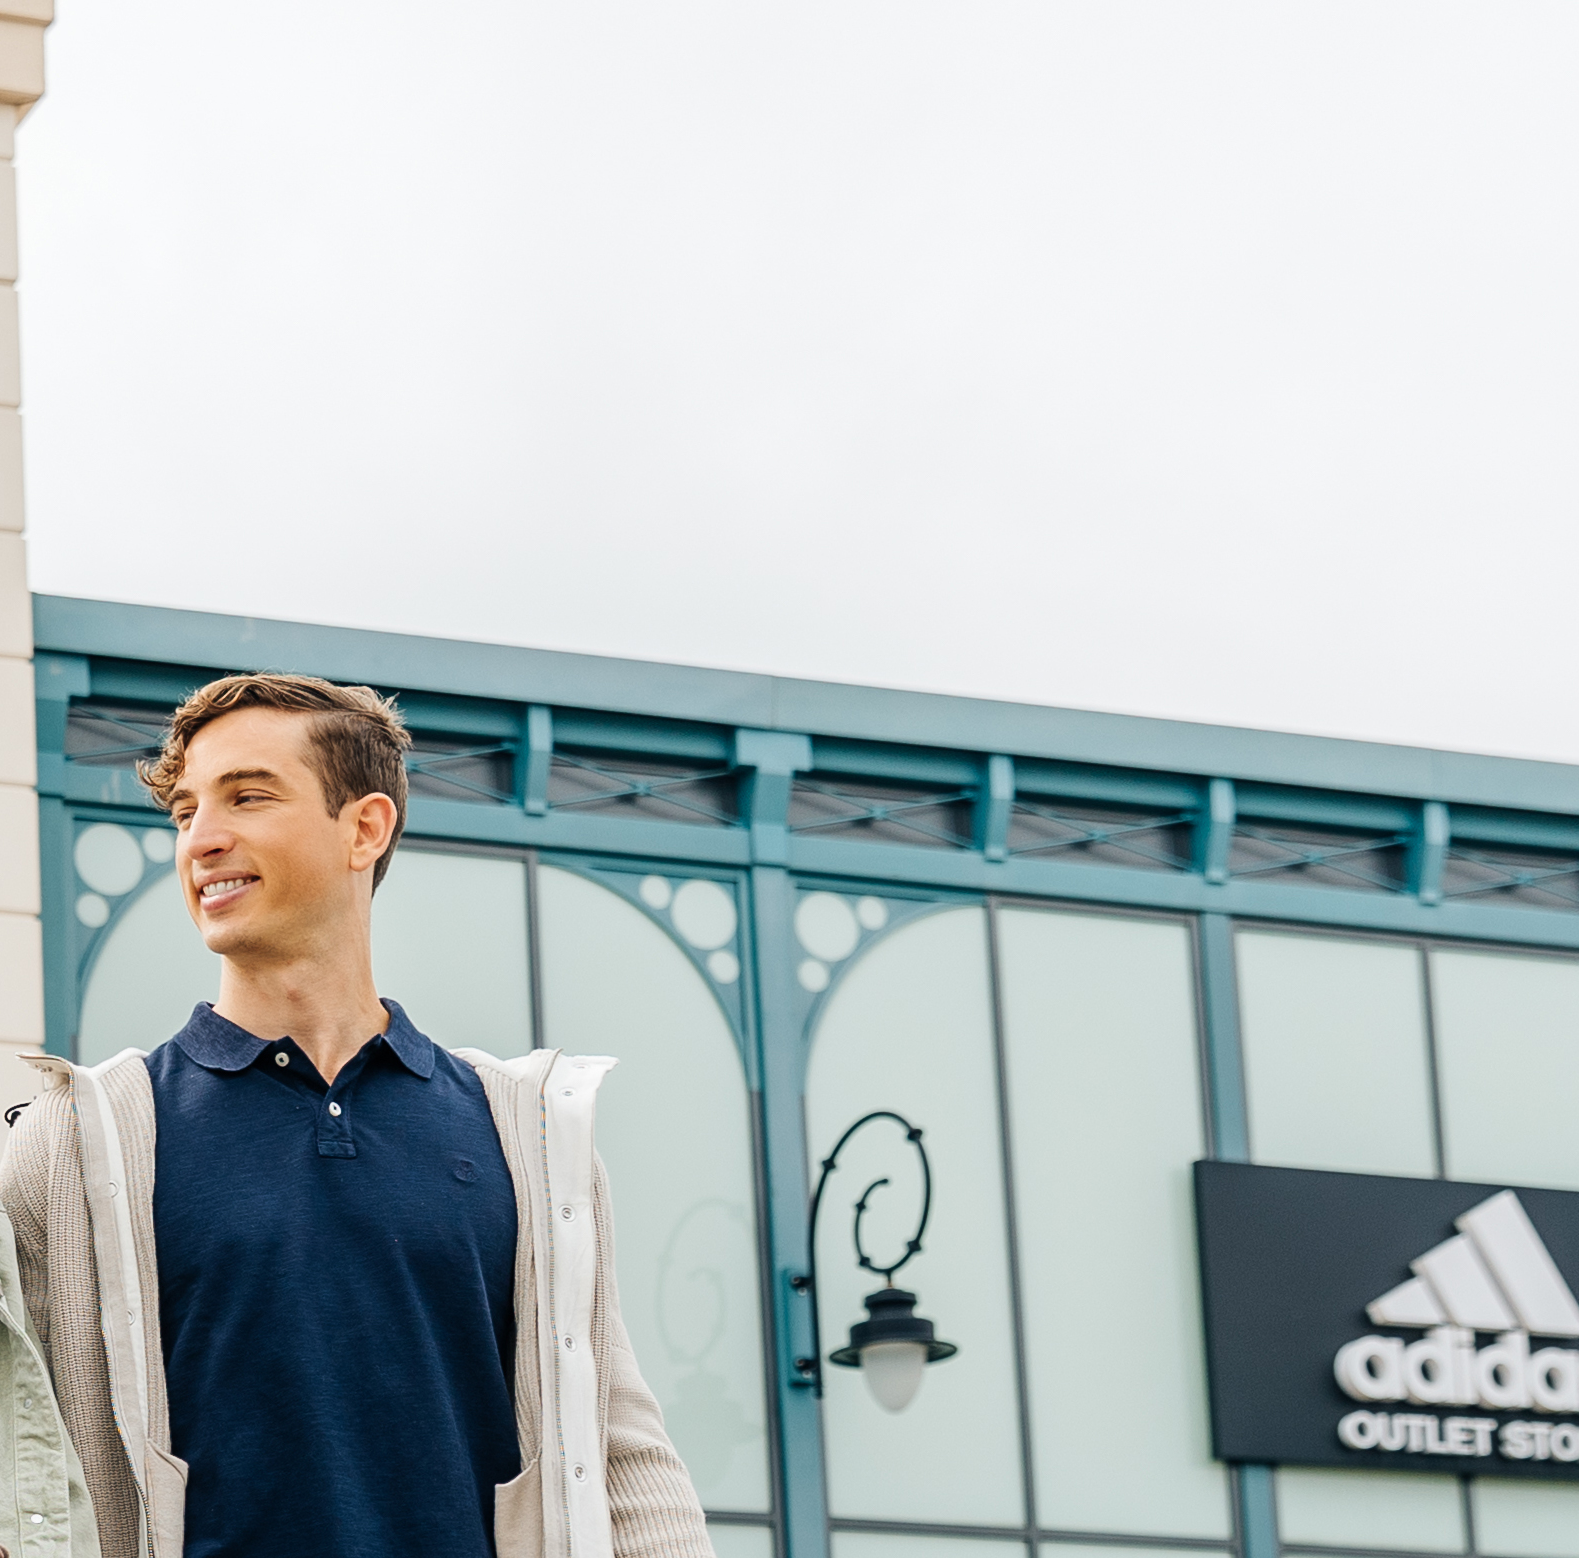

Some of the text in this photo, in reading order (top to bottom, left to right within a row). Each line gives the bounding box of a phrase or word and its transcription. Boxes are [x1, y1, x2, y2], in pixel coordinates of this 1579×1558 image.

[1334, 1324, 1579, 1414] adida
[1338, 1409, 1579, 1462] OUTLET STO
